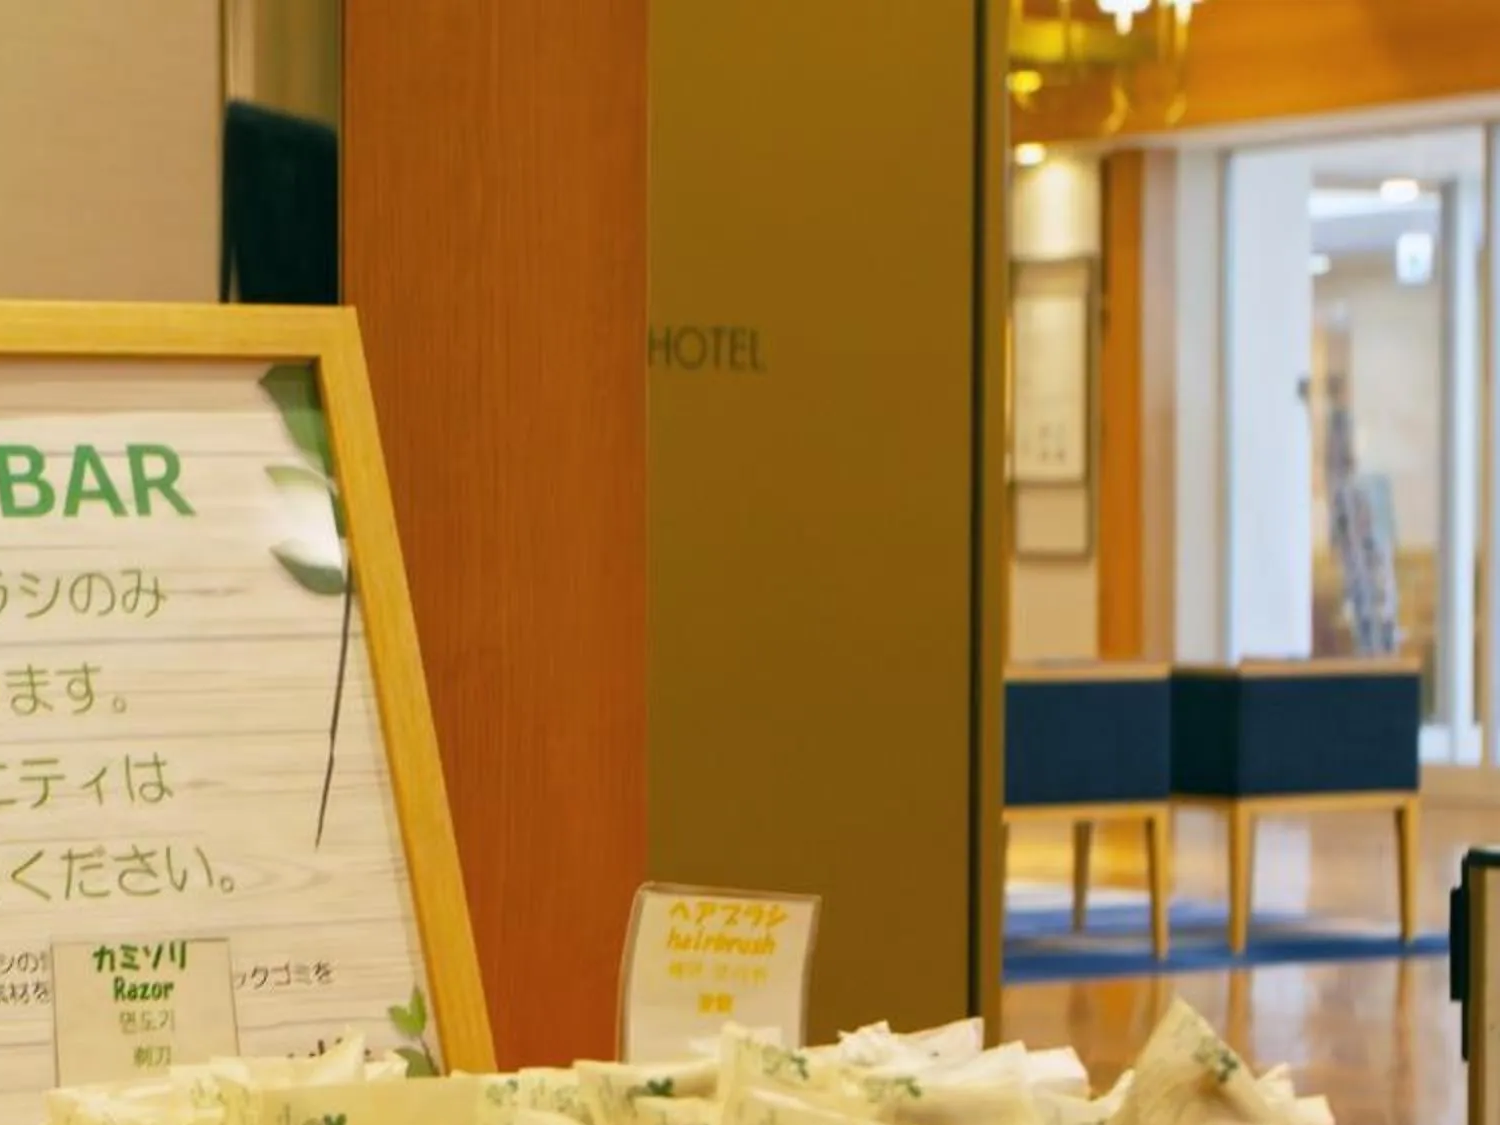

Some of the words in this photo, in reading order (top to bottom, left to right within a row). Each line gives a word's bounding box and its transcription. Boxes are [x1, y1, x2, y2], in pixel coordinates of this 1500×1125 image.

[647, 325, 767, 374] HOTEL
[93, 941, 188, 972] カミソリ
[113, 976, 174, 1002] Razor
